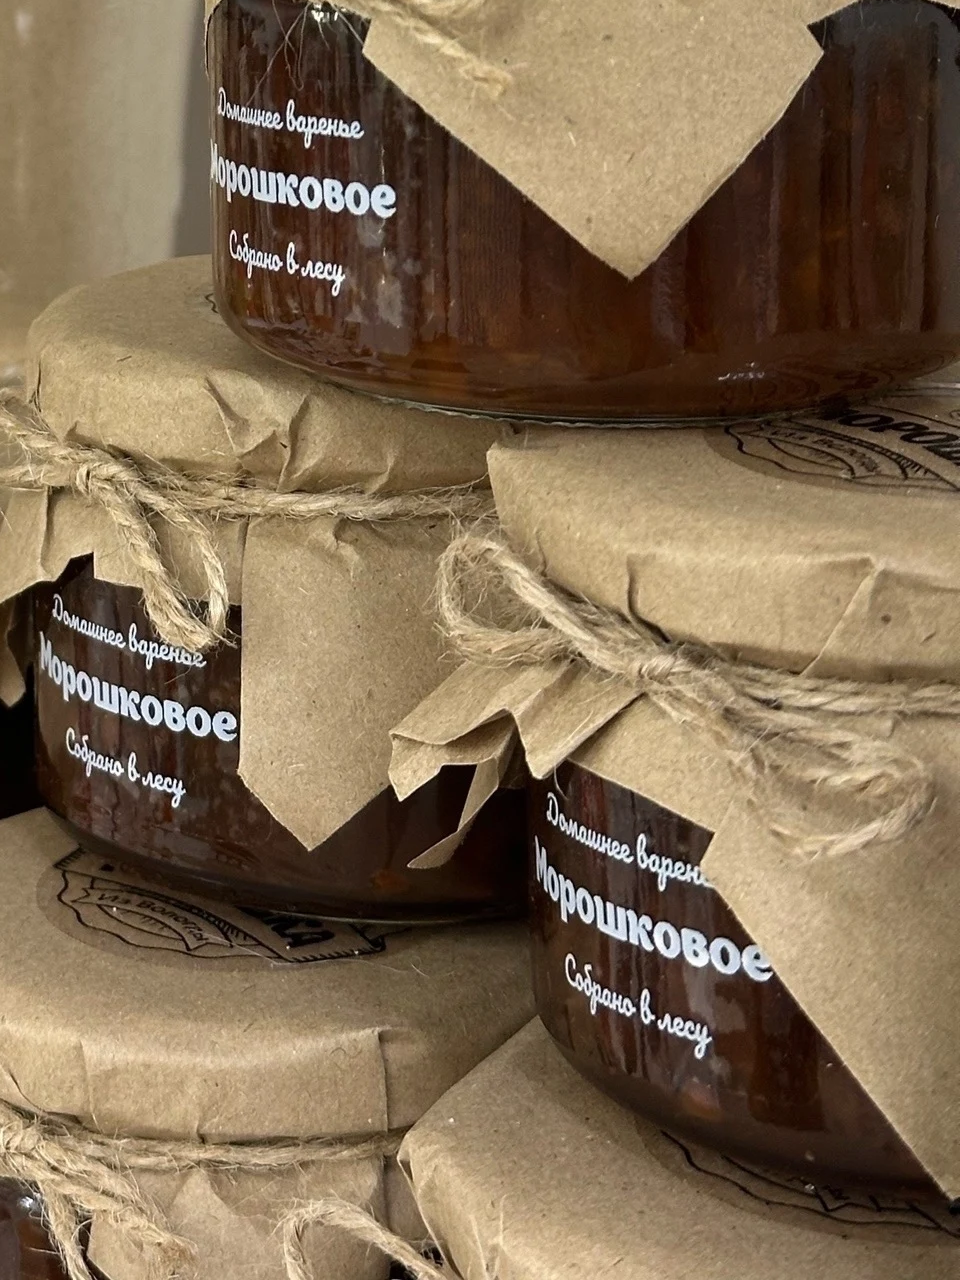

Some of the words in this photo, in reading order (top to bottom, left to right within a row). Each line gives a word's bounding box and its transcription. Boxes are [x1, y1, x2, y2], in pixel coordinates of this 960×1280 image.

[217, 87, 284, 130] Домашнее
[285, 99, 365, 150] варенье
[210, 138, 397, 219] Морошковое
[229, 229, 284, 280] Собрано
[285, 241, 300, 275] в
[301, 260, 346, 297] лесу
[52, 593, 127, 649] Домашнее
[40, 631, 238, 742] Морошковое
[66, 726, 125, 778] Собрано
[127, 751, 140, 782] в
[142, 770, 187, 809] лесу
[546, 792, 635, 864] Домашнее
[536, 835, 774, 982] Морошковое
[565, 952, 637, 1016] Собрано
[639, 988, 656, 1025] в
[657, 1012, 713, 1060] лесу
